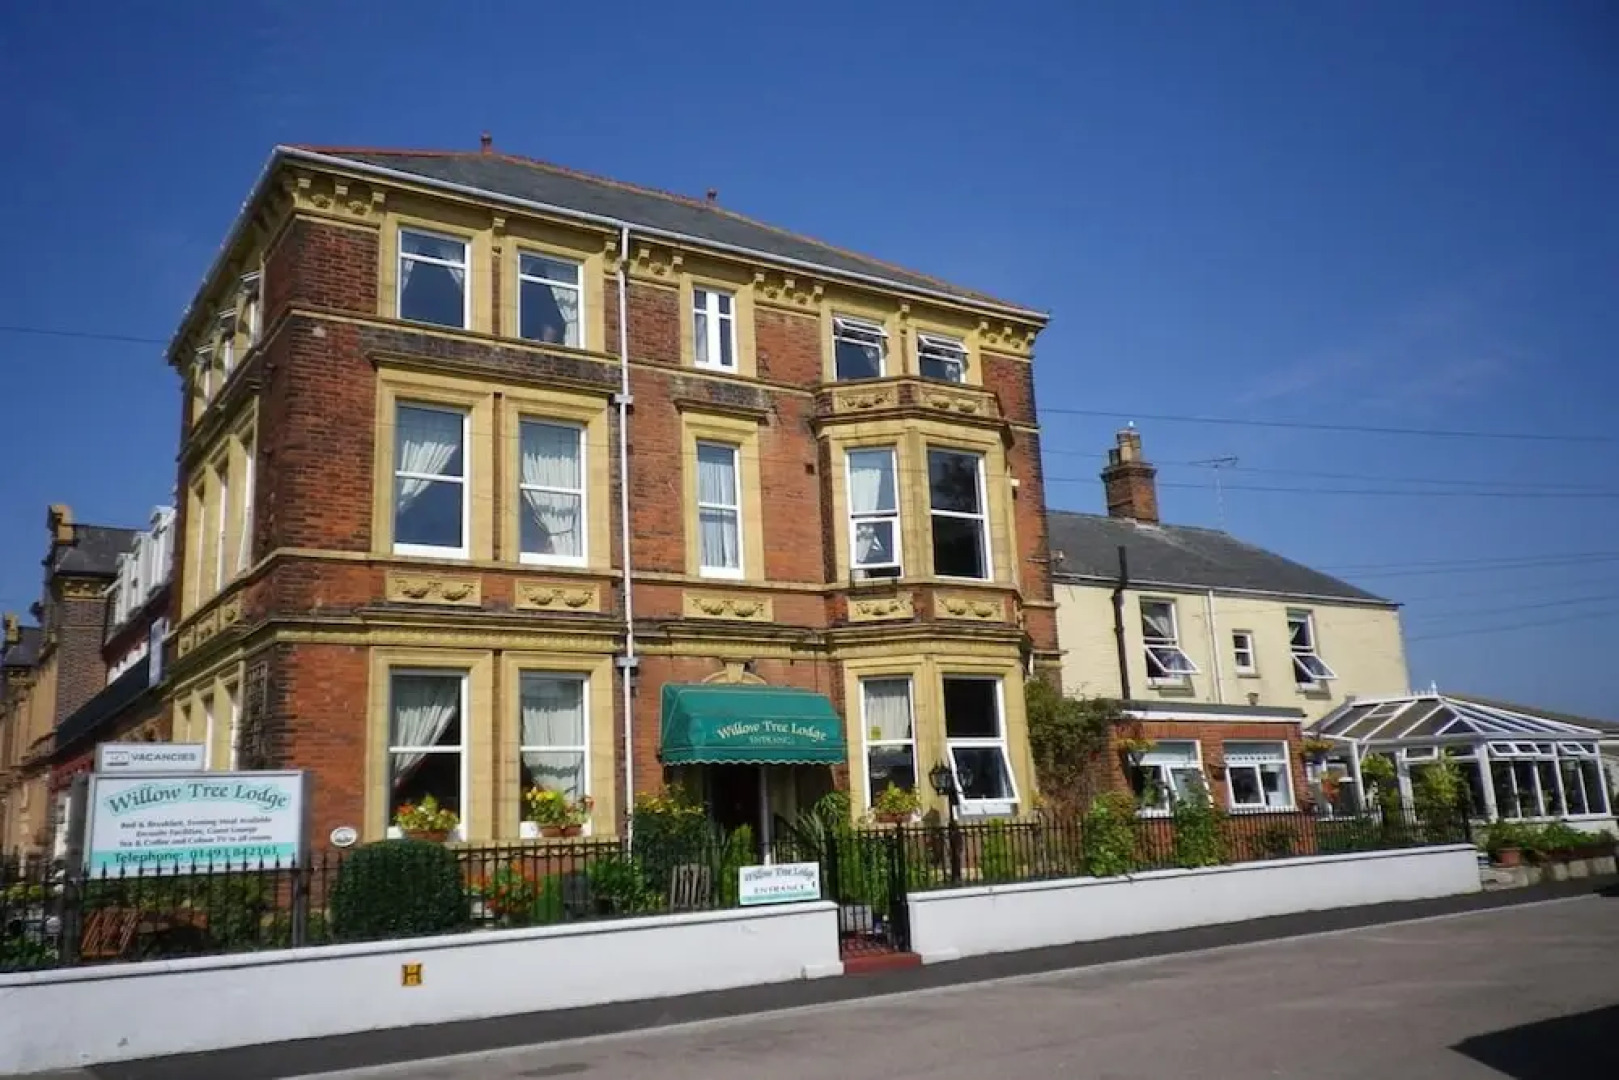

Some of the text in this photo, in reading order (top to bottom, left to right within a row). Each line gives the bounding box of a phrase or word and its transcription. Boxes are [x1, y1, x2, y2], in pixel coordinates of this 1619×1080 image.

[717, 720, 828, 743] Willow Tree Lodge
[131, 751, 197, 762] VACANCIES
[108, 782, 289, 813] Willow Tree Lodge
[115, 849, 184, 864] Telephone:
[744, 866, 814, 882] Willow Tree Lodge
[754, 884, 804, 894] ENTRANCE
[401, 963, 422, 986] H
